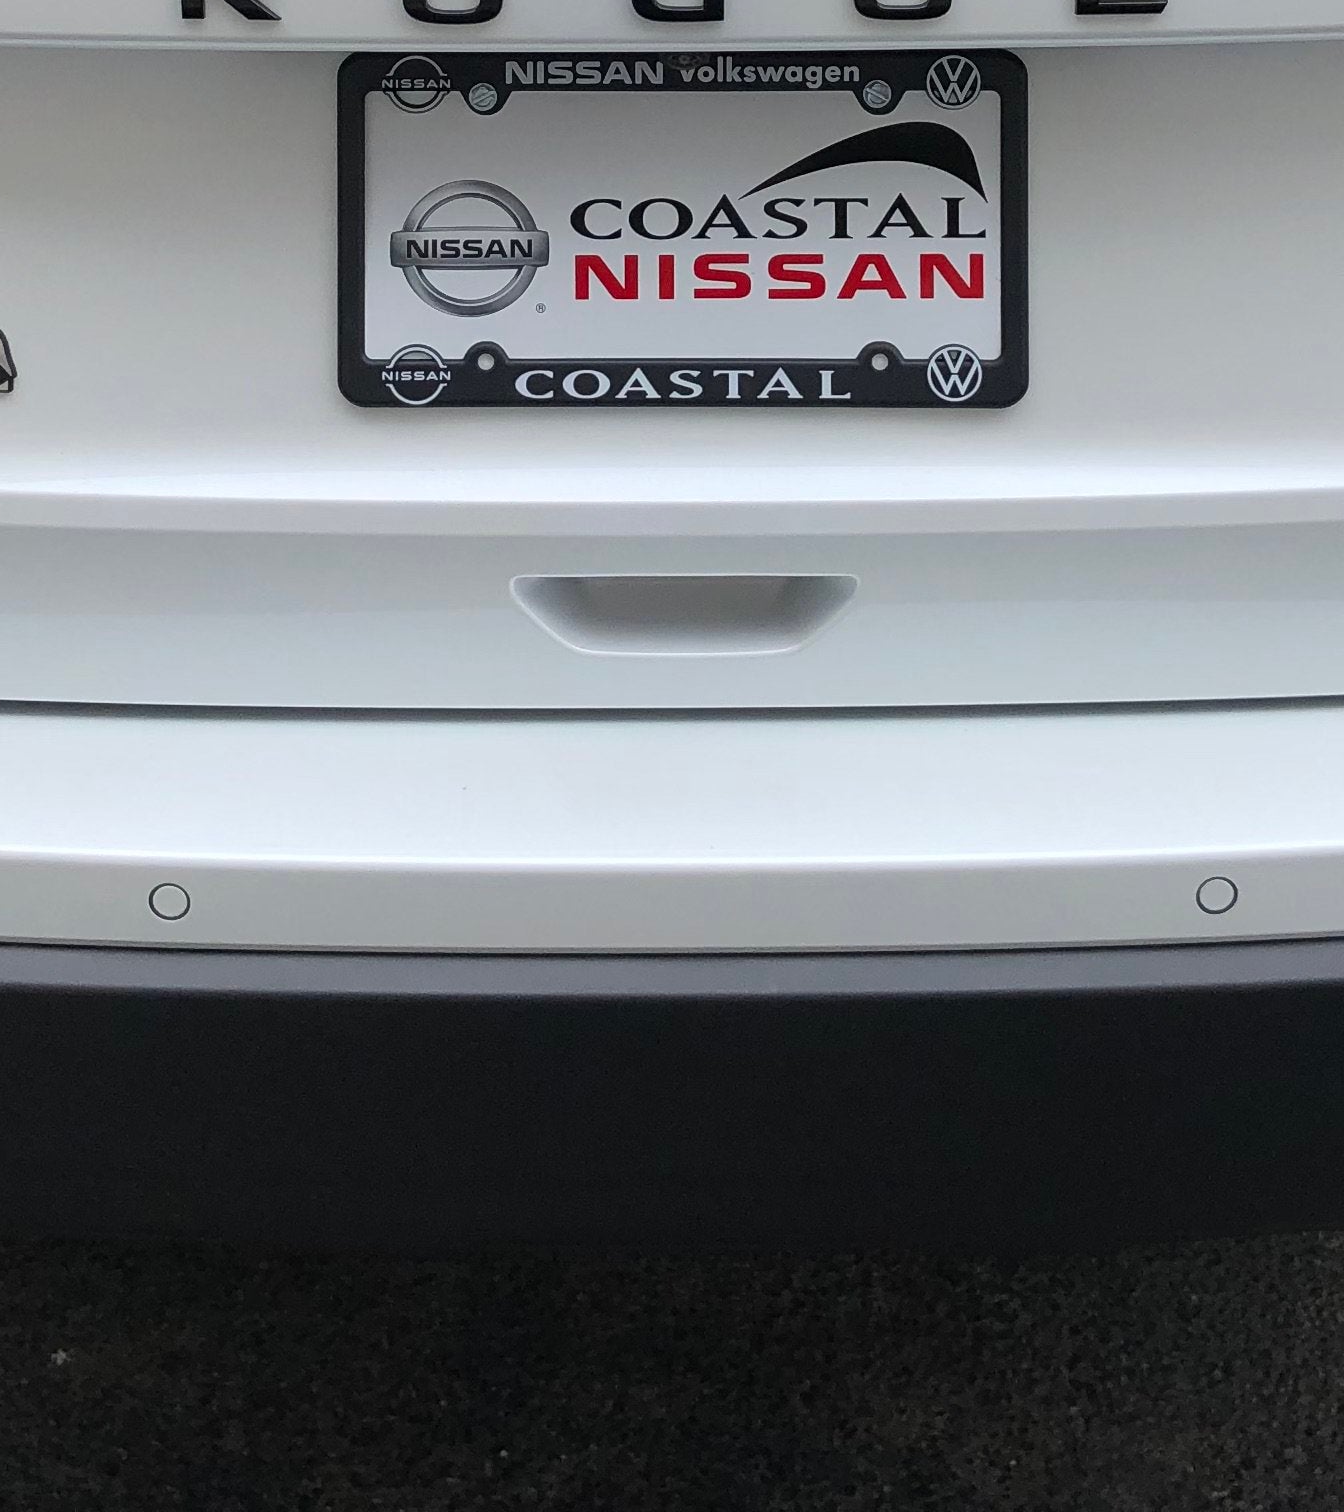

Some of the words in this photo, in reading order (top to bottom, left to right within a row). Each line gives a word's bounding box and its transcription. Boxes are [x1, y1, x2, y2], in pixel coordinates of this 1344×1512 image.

[381, 78, 451, 90] NISSAN
[505, 60, 664, 85] NISSAN
[570, 193, 987, 240] COASTAL
[405, 238, 534, 259] NISSAN
[574, 253, 985, 300] NISSAN
[381, 370, 451, 381] NISSAN
[514, 367, 851, 399] COASTAL
